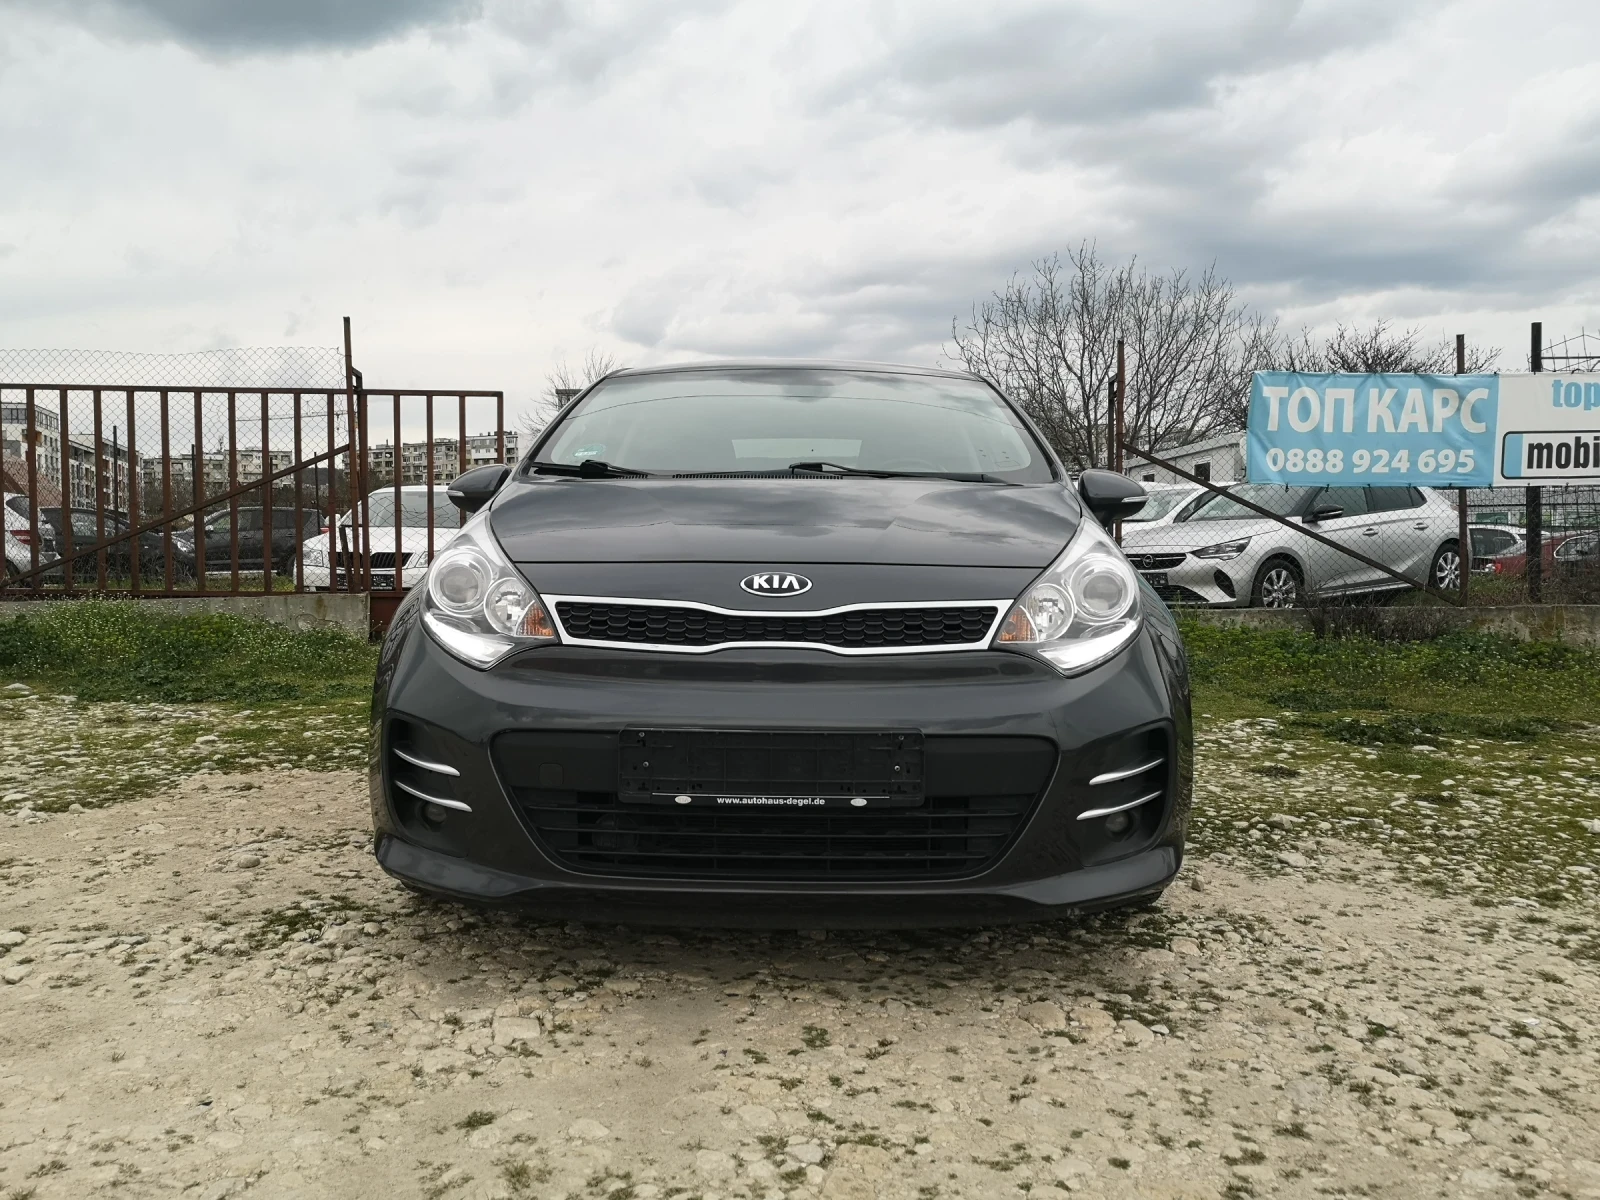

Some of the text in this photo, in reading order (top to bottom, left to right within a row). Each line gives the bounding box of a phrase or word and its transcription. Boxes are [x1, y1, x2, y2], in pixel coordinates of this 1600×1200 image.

[1552, 379, 1600, 410] top
[1263, 386, 1489, 433] ТОП КАРС
[1266, 447, 1475, 473] 0888 924 695
[1527, 436, 1600, 469] mobi
[753, 574, 800, 590] KIA
[716, 797, 826, 806] www.autohaus-degel.de
